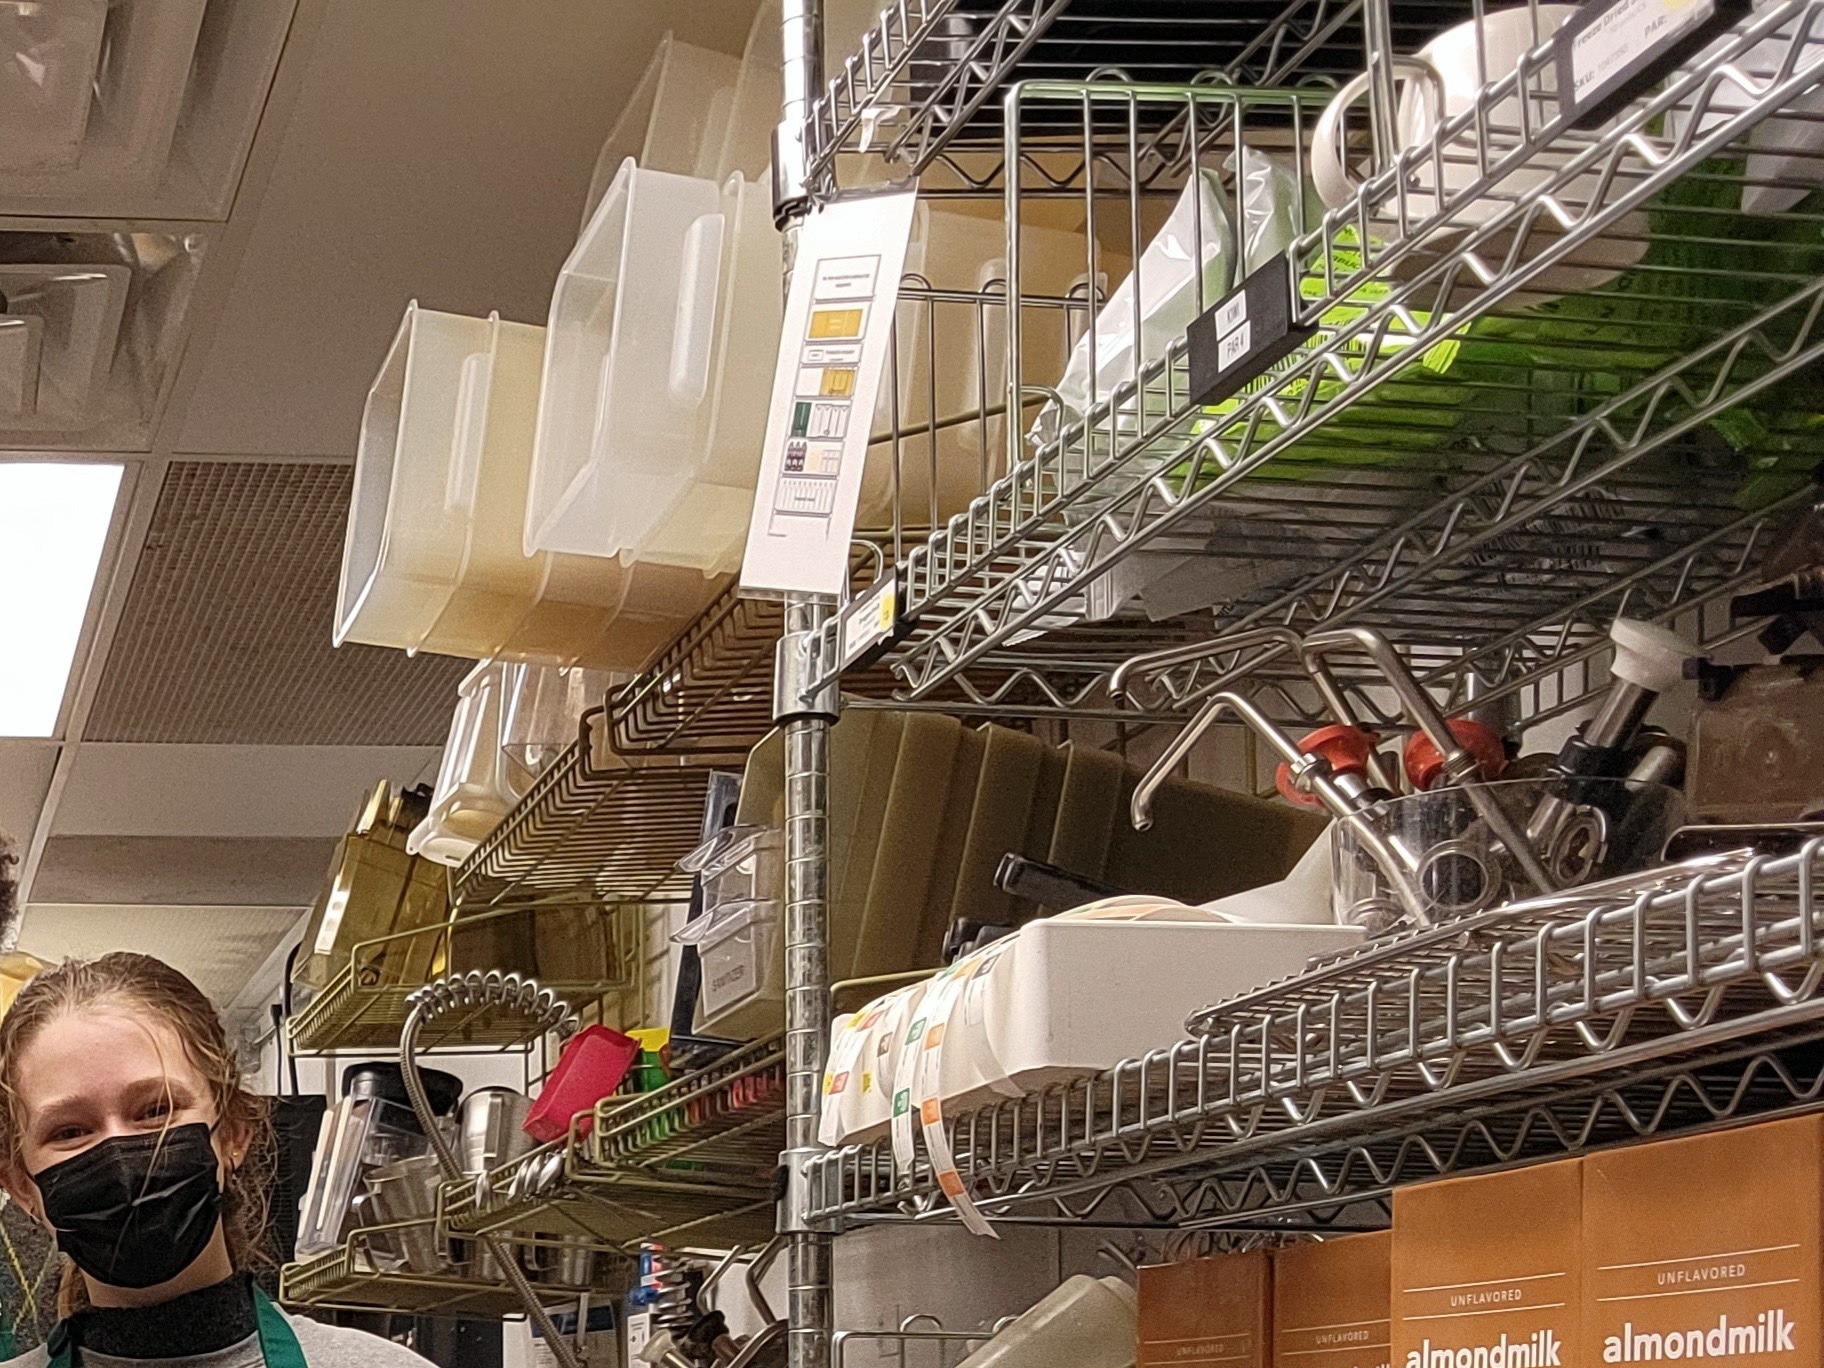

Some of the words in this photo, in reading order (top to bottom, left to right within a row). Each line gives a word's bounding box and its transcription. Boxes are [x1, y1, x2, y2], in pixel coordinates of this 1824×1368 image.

[1656, 1263, 1746, 1286] UNFLAVORED
[1450, 1288, 1522, 1308] UNFLAVORED
[1602, 1308, 1796, 1364] almondmilk
